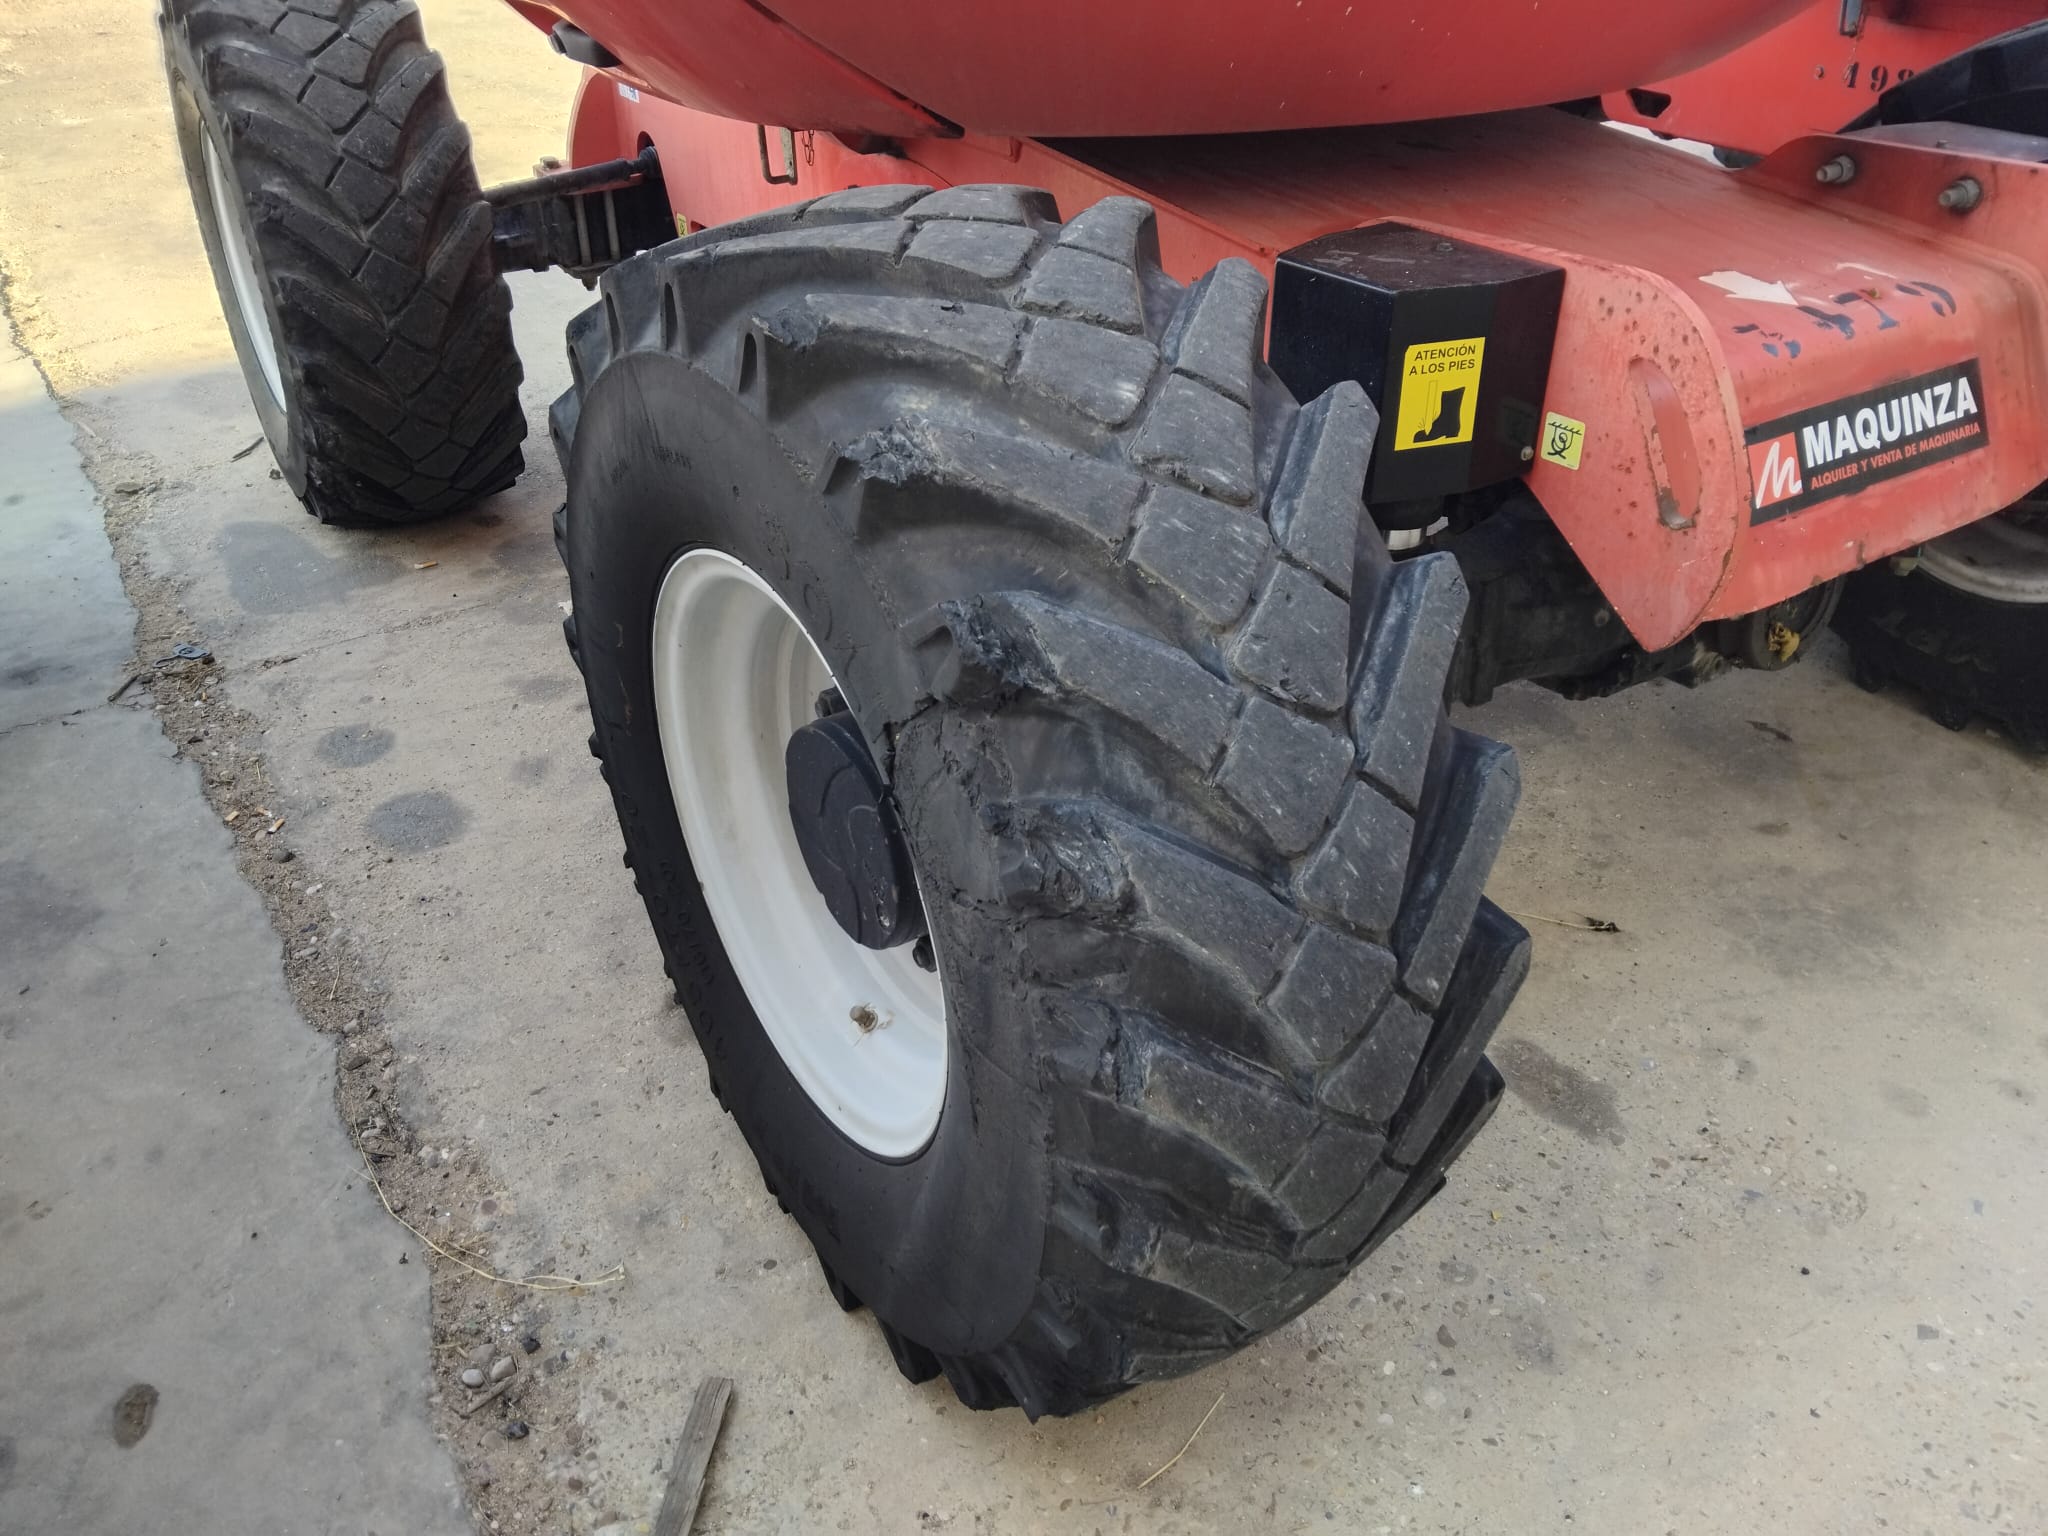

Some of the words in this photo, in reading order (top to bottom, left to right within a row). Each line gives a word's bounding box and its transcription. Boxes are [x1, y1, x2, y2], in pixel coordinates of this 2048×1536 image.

[1409, 365, 1418, 376] A
[1421, 361, 1445, 375] LOS
[1448, 358, 1476, 372] PIES
[1414, 343, 1476, 361] ATENCIÓN
[1802, 376, 1978, 468] MAQUINZA
[1810, 464, 1858, 490] ALQUILER
[1860, 458, 1868, 472] Y
[1870, 449, 1903, 470] VENTA
[1905, 444, 1917, 459] DE
[1919, 422, 1981, 452] MAQUINARIA
